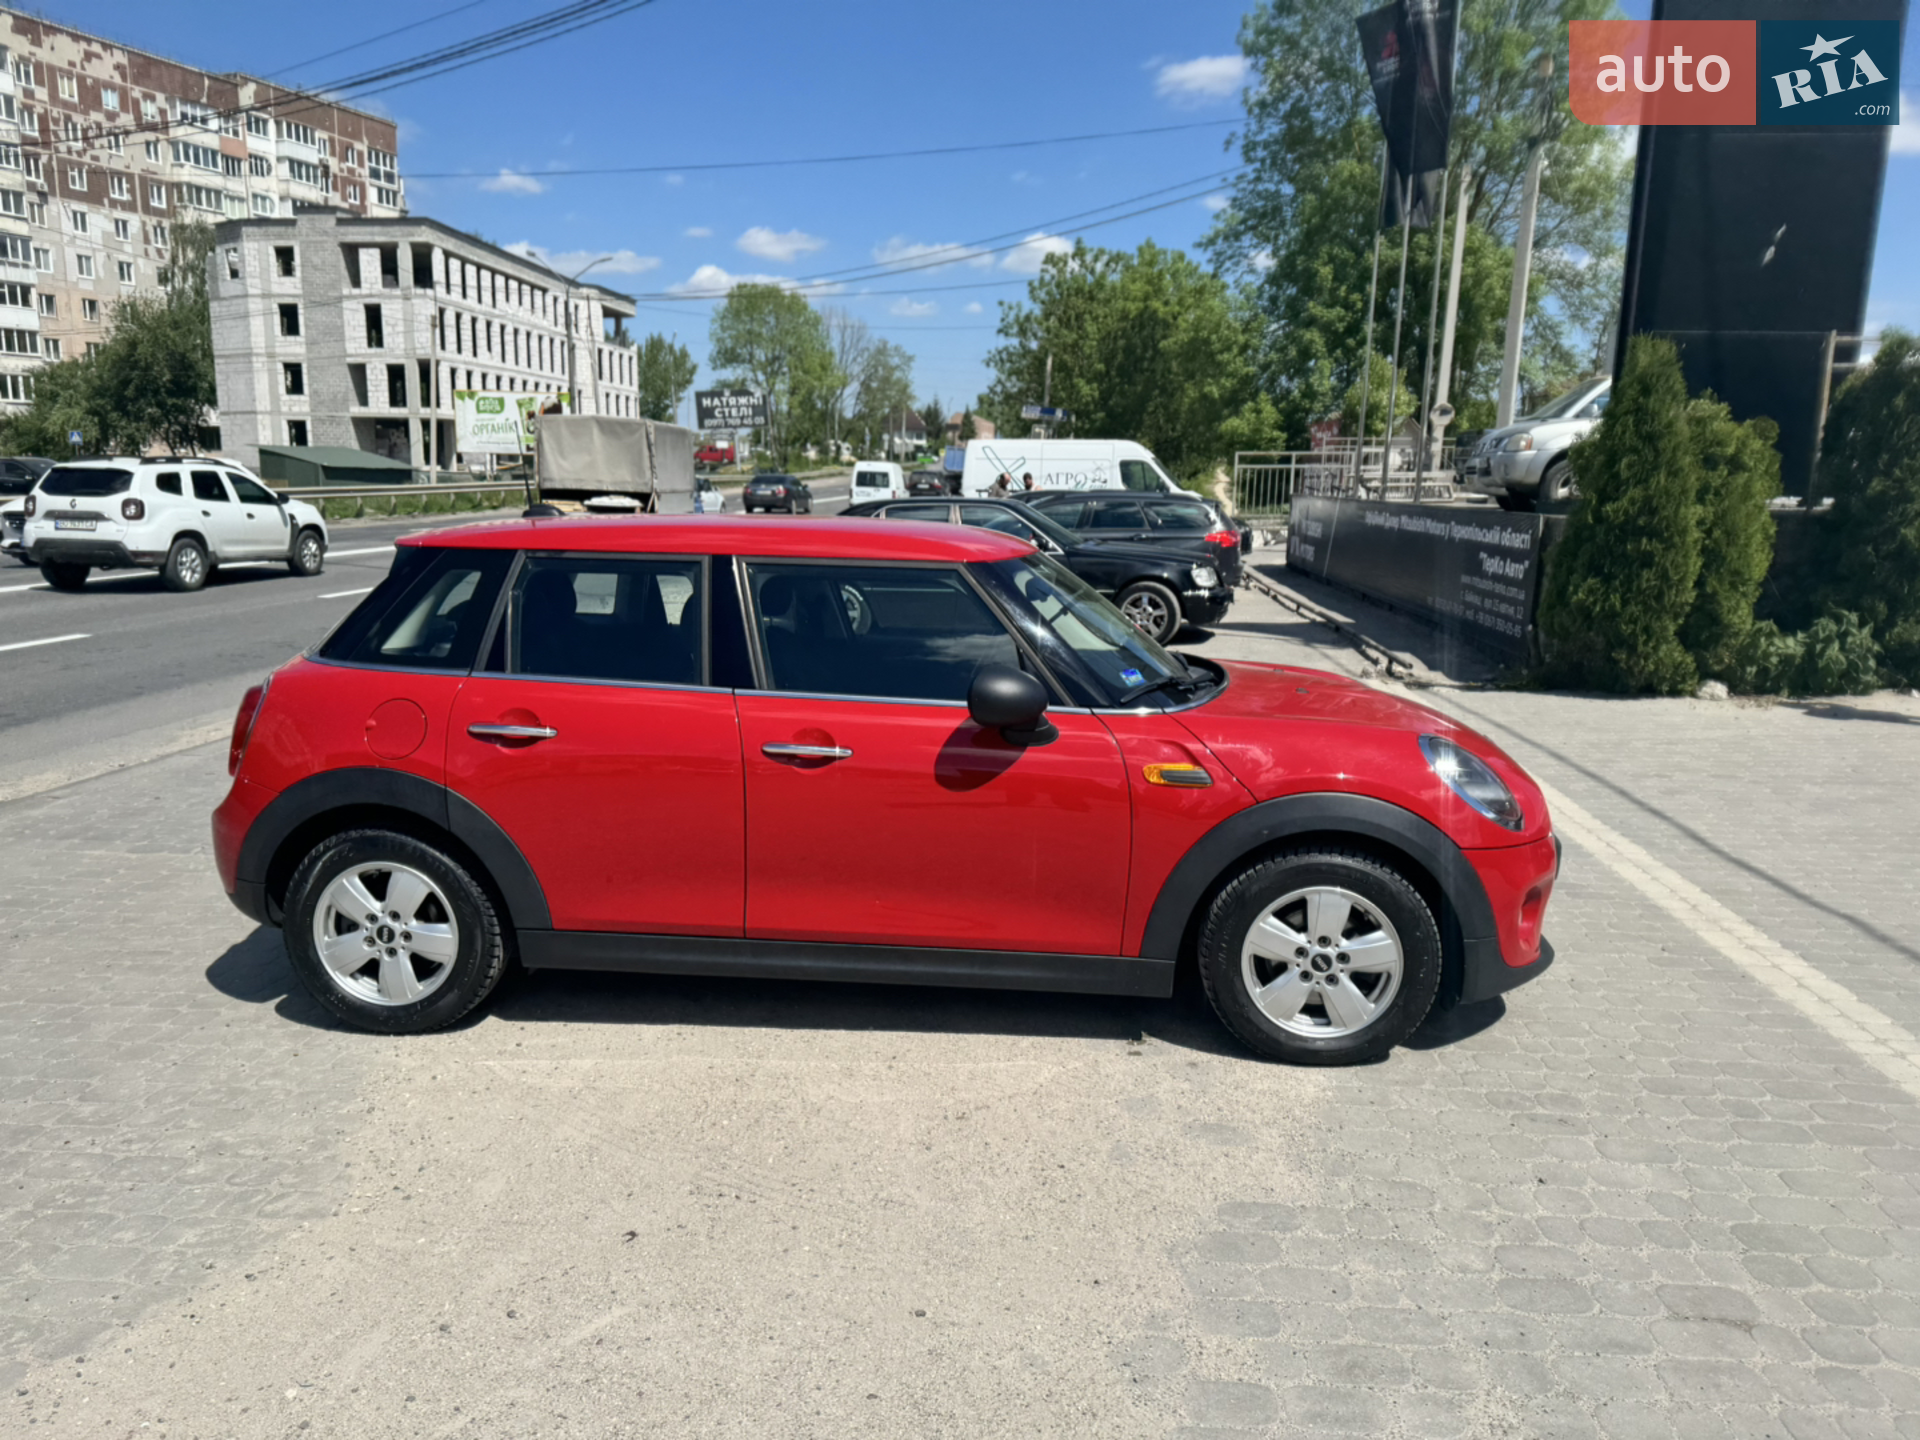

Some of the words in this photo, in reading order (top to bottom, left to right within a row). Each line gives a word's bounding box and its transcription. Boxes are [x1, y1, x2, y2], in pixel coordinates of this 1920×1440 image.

[702, 395, 763, 408] НАТЯЖНІ
[714, 407, 753, 418] СТЕЛІ
[1044, 471, 1088, 488] АГРО
[1501, 526, 1532, 549] області
